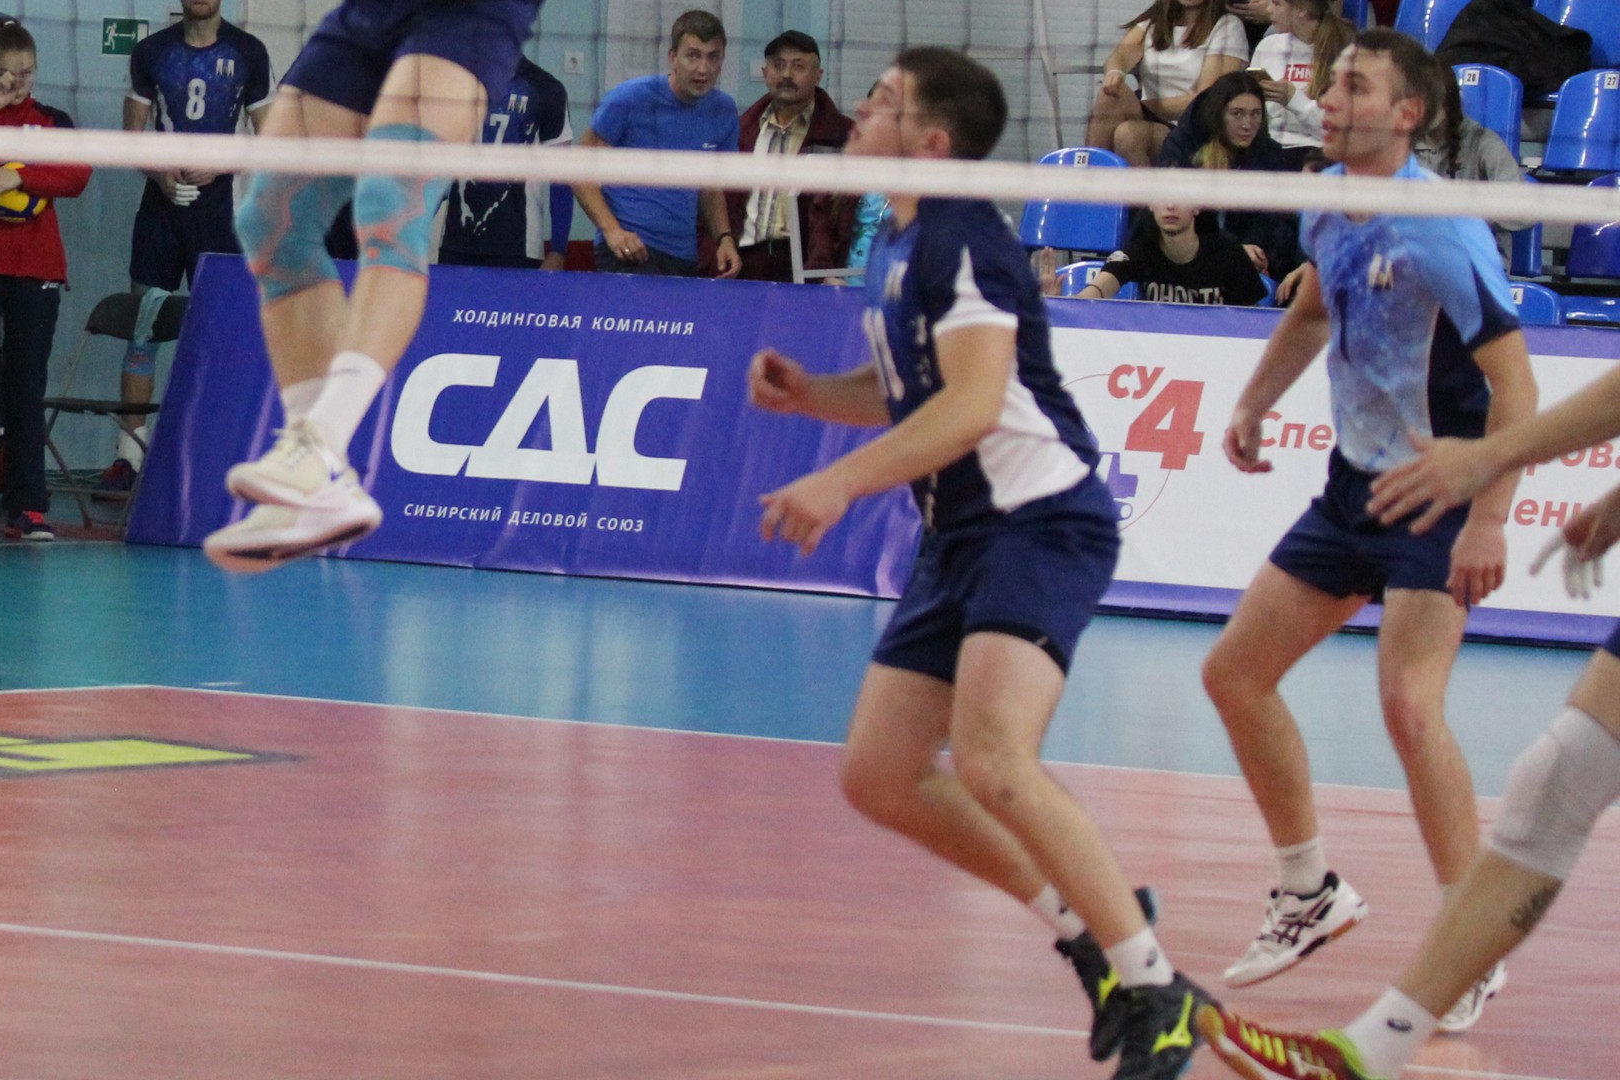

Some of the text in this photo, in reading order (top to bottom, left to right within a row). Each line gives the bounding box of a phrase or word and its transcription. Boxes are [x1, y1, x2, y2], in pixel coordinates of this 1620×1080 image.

[1606, 76, 1617, 86] 27
[185, 77, 207, 121] 8
[453, 309, 695, 336] ХОЛДИНГОВАЯ КОМПАНИЯ
[1124, 378, 1205, 471] 4
[403, 502, 644, 532] СИБИРСКИЙ ДЕЛОВОЙ СОЮЗ
